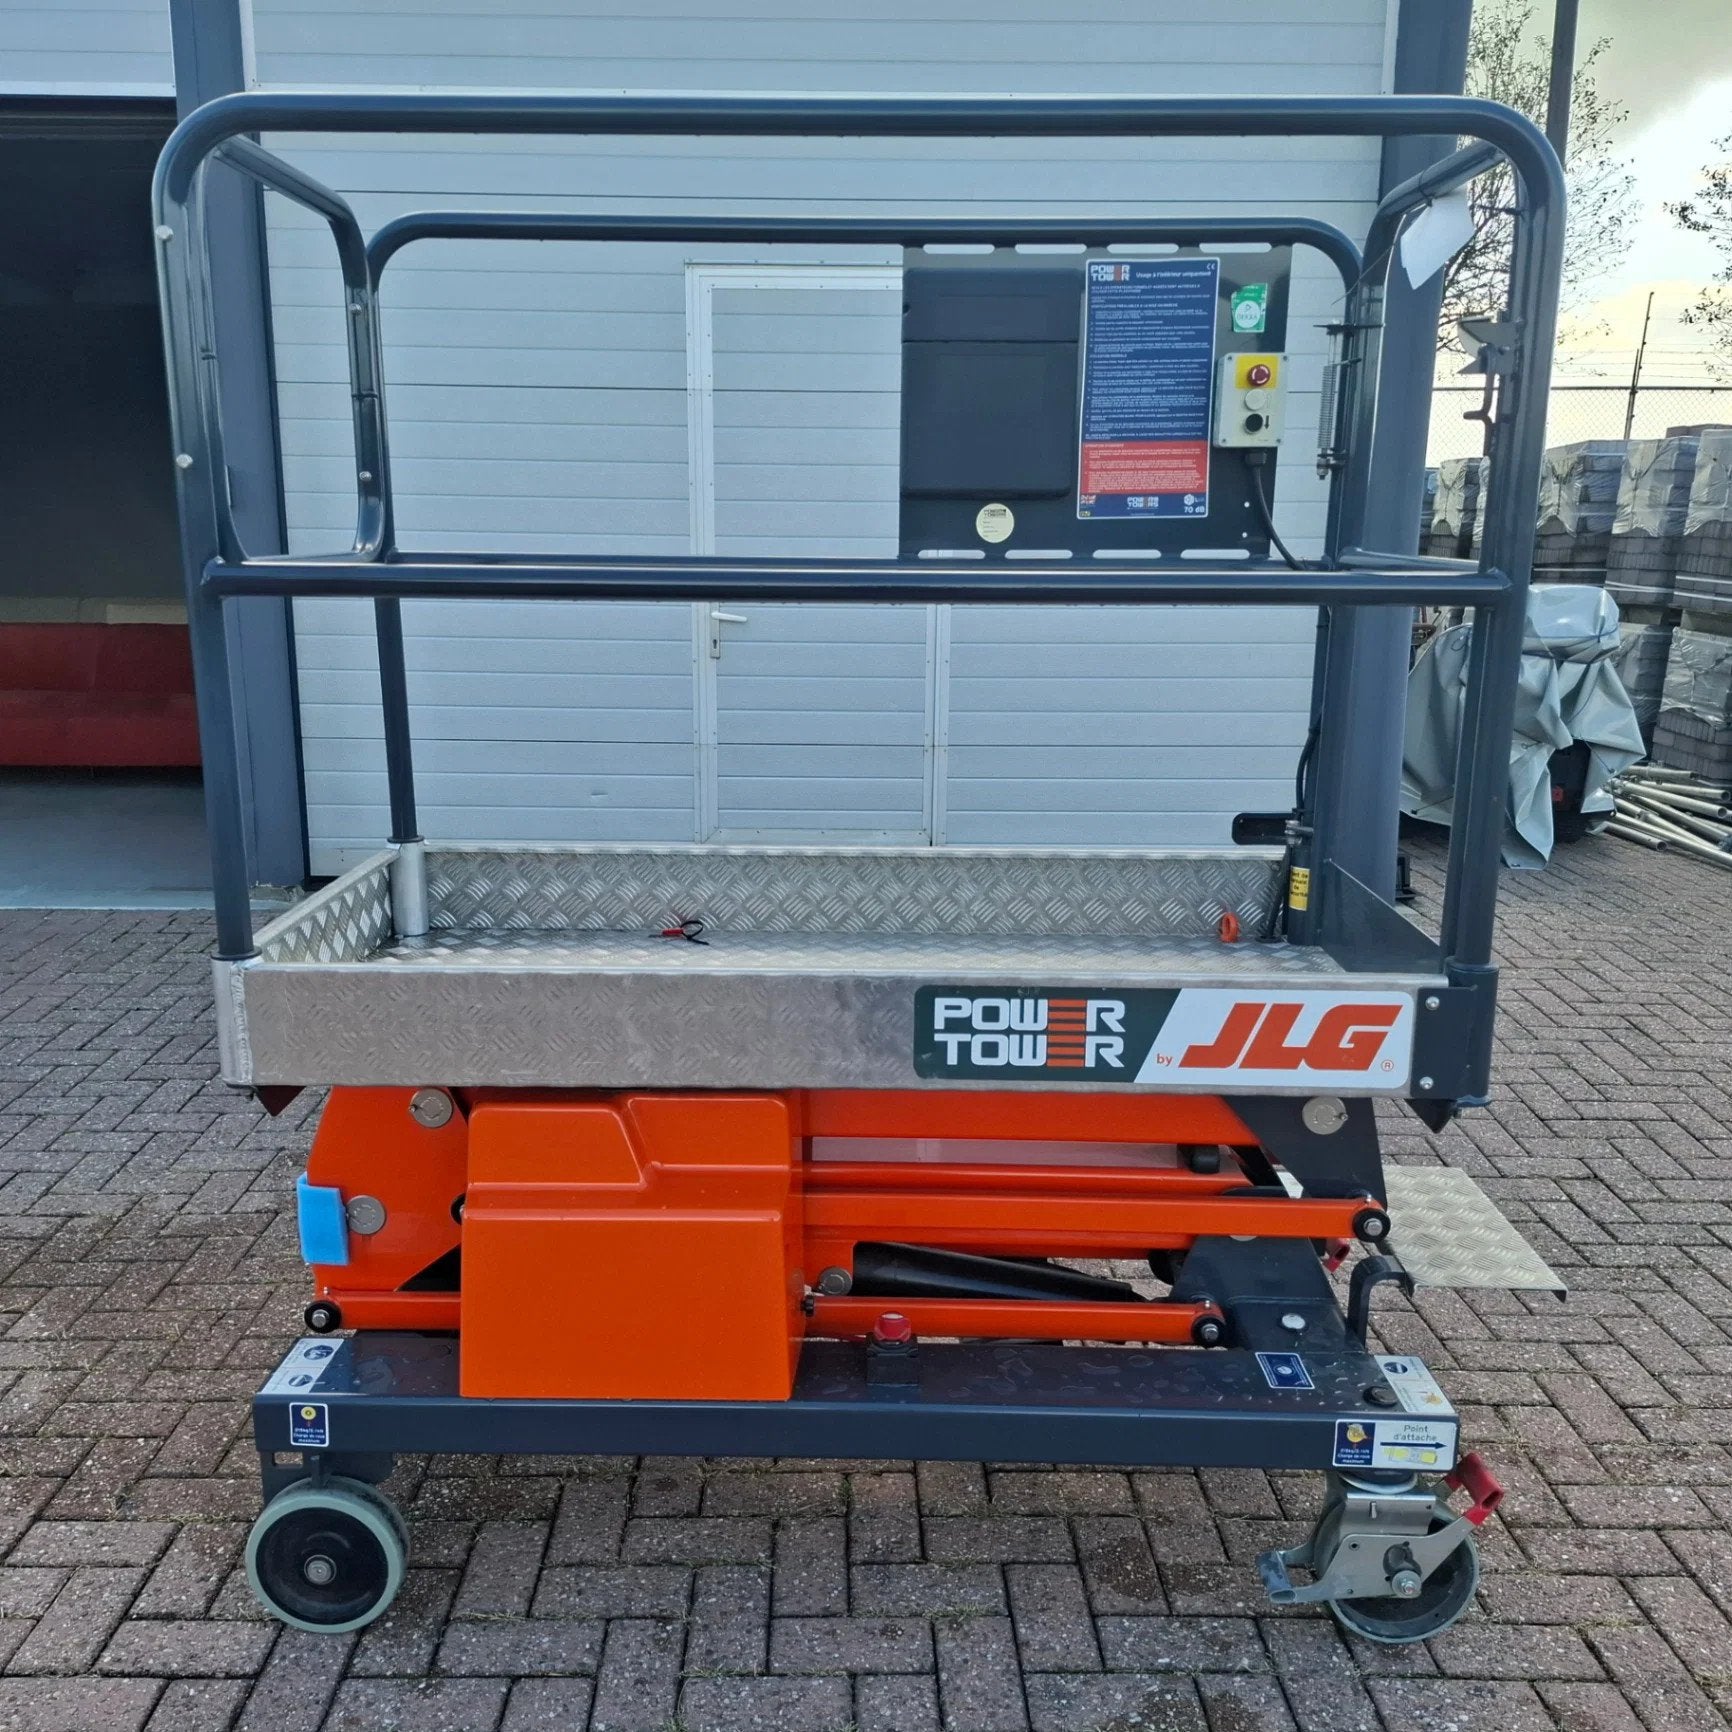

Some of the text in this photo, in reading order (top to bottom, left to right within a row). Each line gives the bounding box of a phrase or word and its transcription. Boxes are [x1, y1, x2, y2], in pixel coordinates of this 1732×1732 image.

[1090, 264, 1130, 273] POWER
[1090, 273, 1130, 282] TOWER
[934, 998, 1125, 1032] POWER
[1156, 1051, 1174, 1067] by
[1178, 1002, 1403, 1071] JLG
[934, 1033, 1125, 1068] TOWER
[1403, 1424, 1428, 1432] Point
[1393, 1433, 1437, 1441] d'attache
